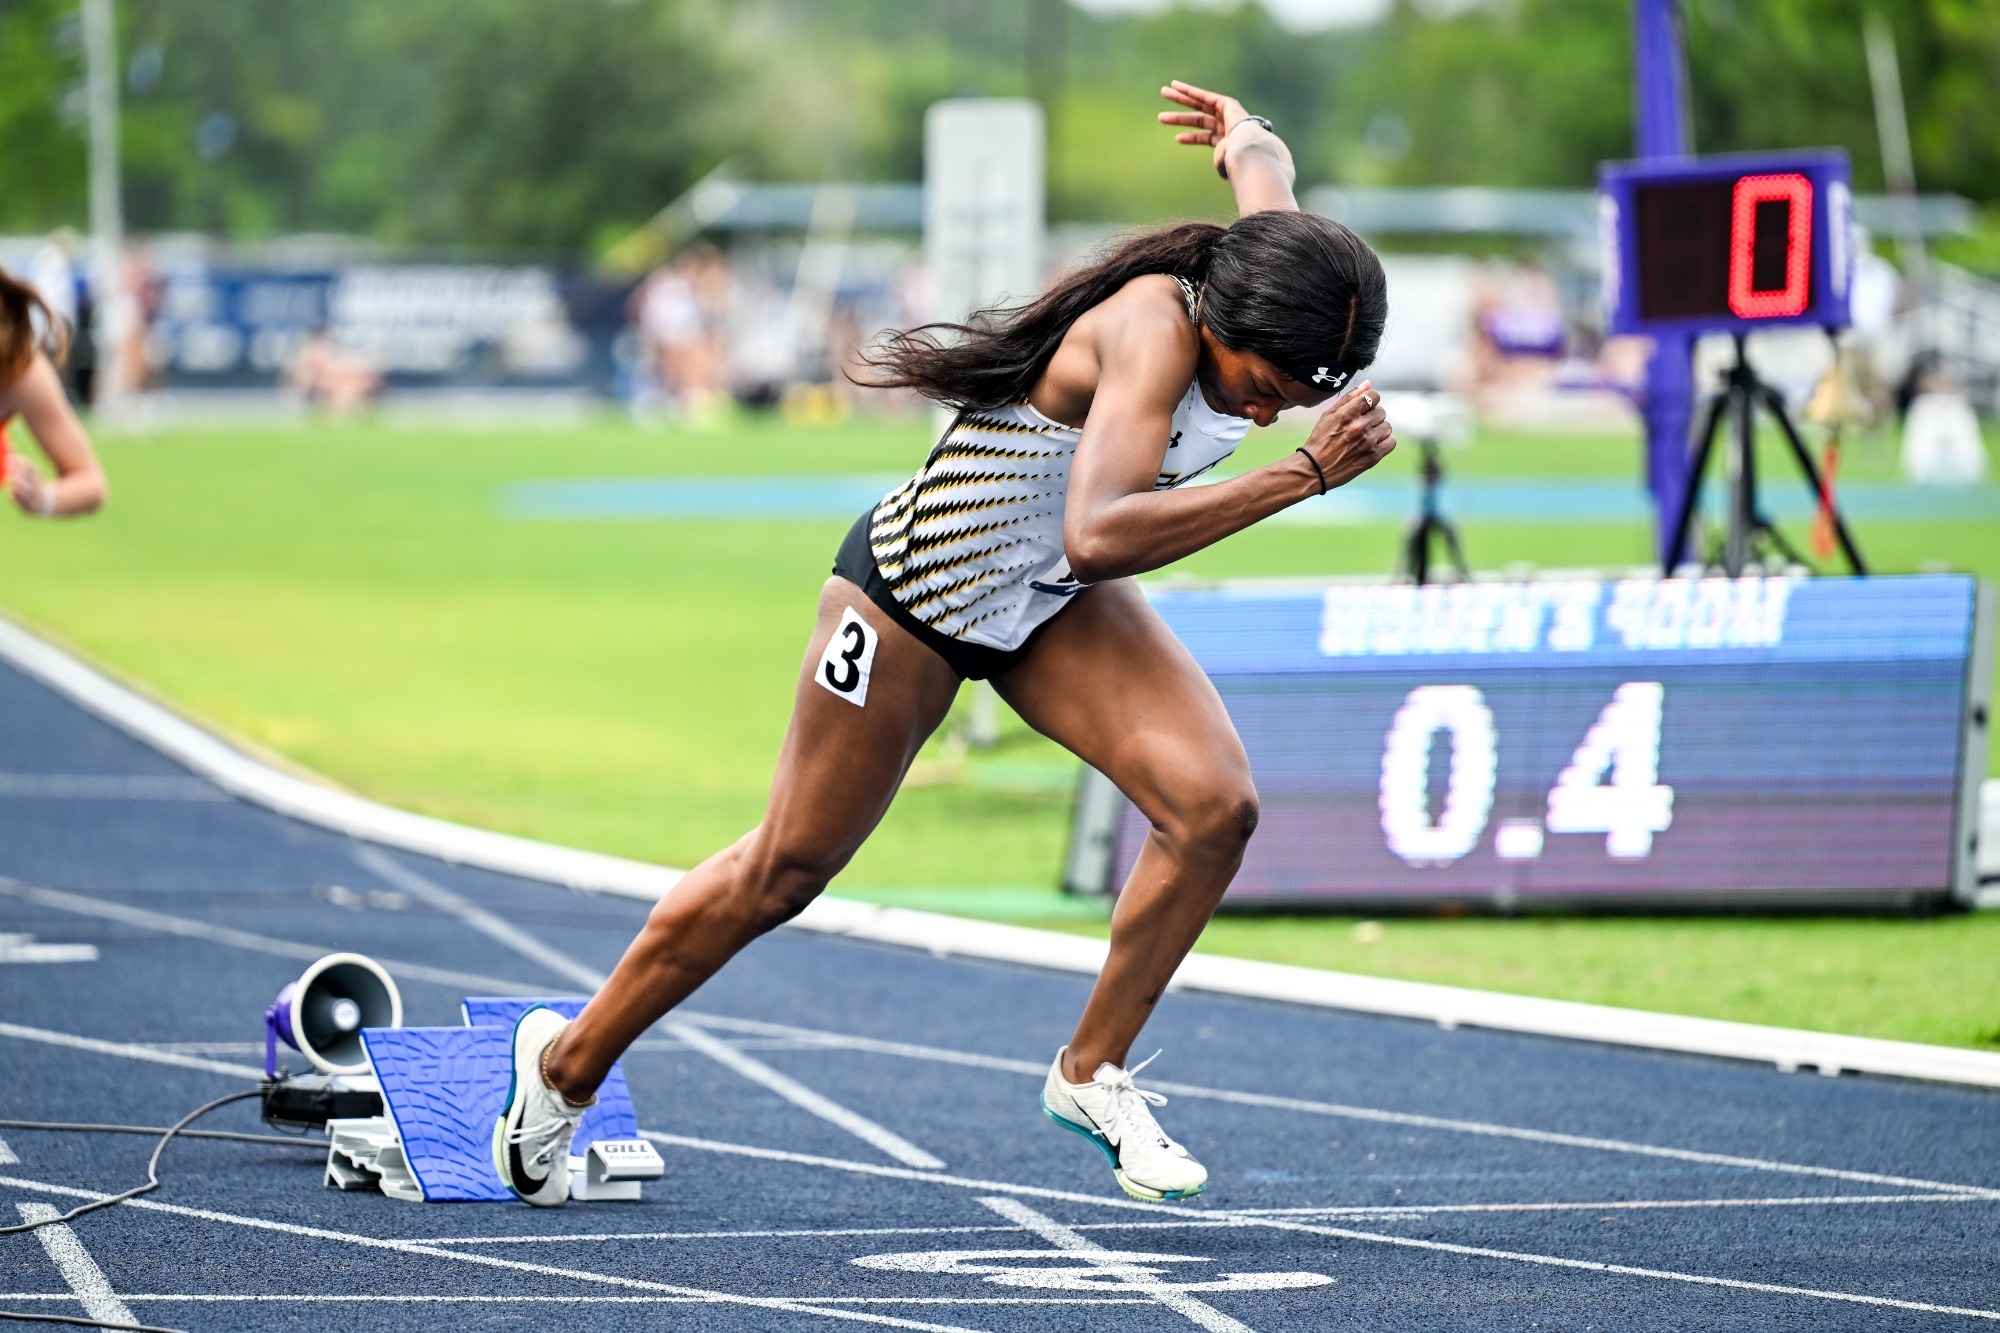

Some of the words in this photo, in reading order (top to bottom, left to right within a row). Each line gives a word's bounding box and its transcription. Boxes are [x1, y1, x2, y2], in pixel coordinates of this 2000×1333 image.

[1728, 173, 1814, 320] 0
[825, 621, 866, 693] 3
[1379, 681, 1675, 863] 0.4
[604, 1144, 649, 1153] GILL
